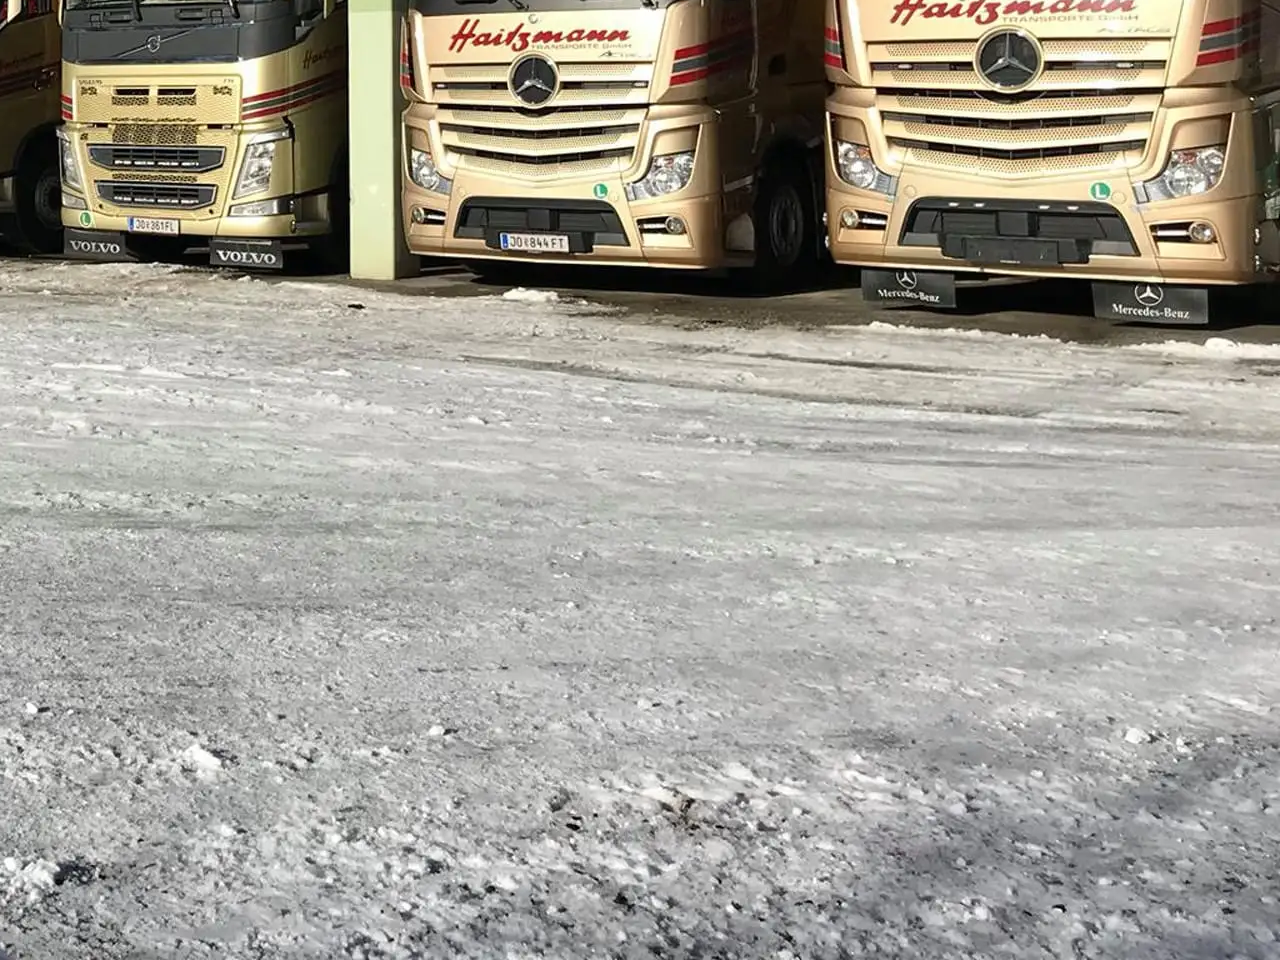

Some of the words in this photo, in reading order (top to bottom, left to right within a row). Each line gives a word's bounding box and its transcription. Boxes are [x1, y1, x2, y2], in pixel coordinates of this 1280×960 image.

[1002, 15, 1094, 23] TRANSPORTE
[448, 18, 630, 53] Haitzmann
[531, 43, 600, 51] TRANSPORTE
[70, 241, 120, 254] VOLVO
[216, 250, 276, 265] VOLVO
[877, 288, 940, 304] Mercedes-Benz
[1112, 303, 1190, 320] Mercedes-Benz
